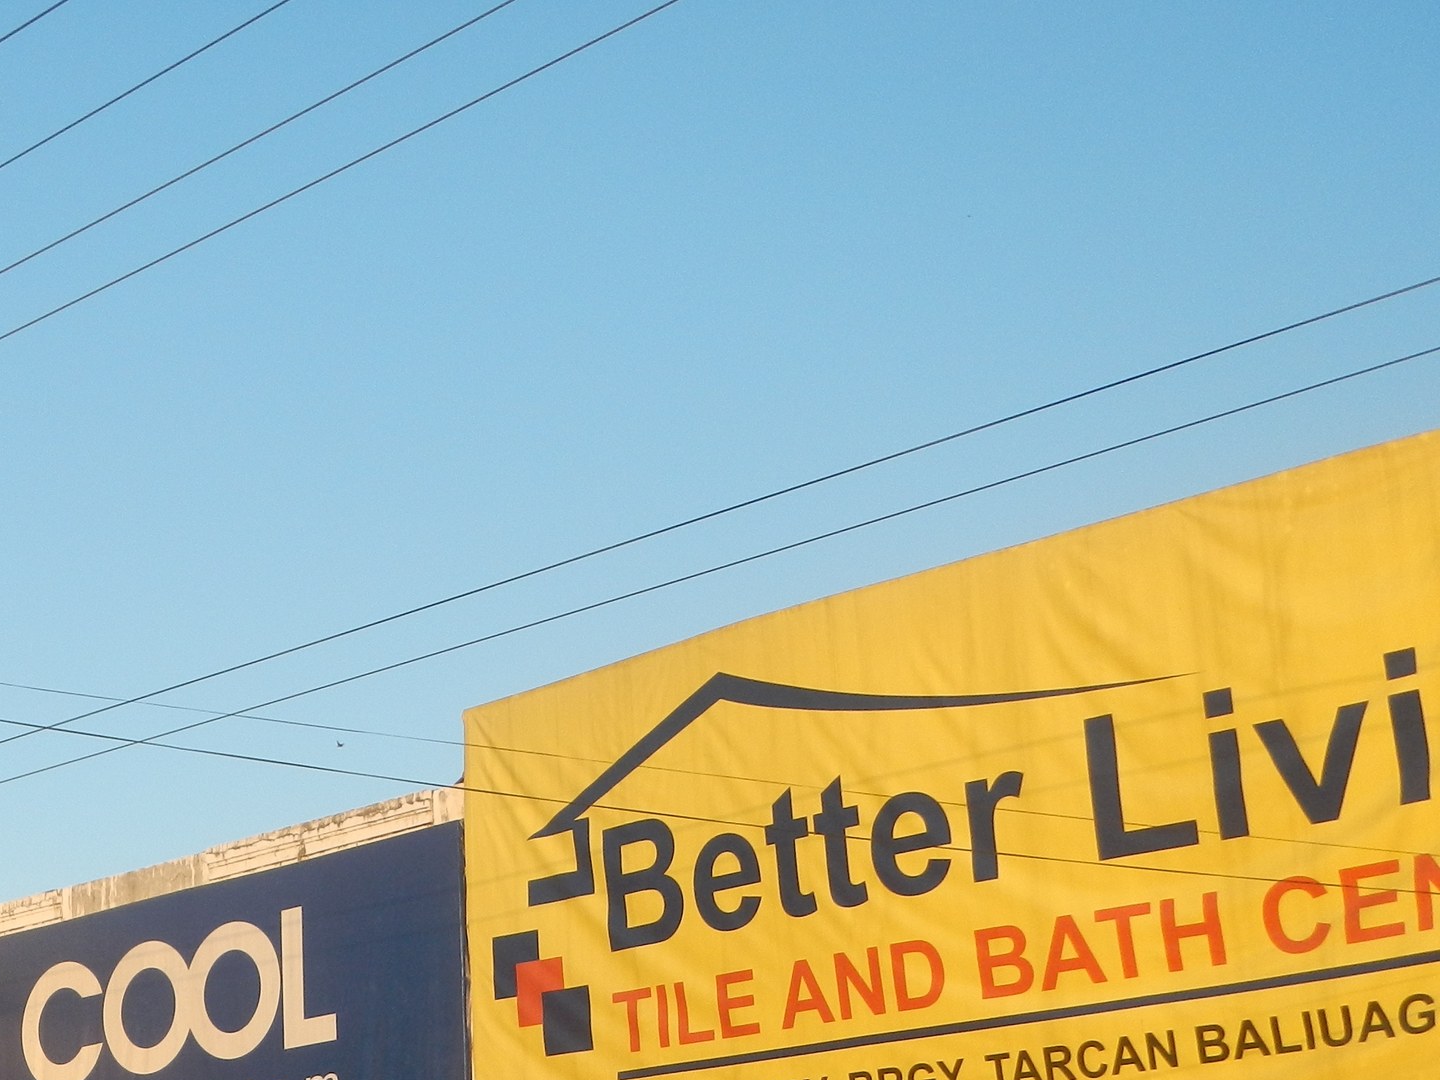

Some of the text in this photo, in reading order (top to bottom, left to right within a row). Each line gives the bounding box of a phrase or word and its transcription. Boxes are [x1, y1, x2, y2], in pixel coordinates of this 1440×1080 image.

[603, 648, 1431, 952] Better Livi
[613, 969, 760, 1053] TILE
[782, 939, 946, 1031] AND
[974, 890, 1227, 1000] BATH
[1197, 992, 1440, 1067] BALIUAG
